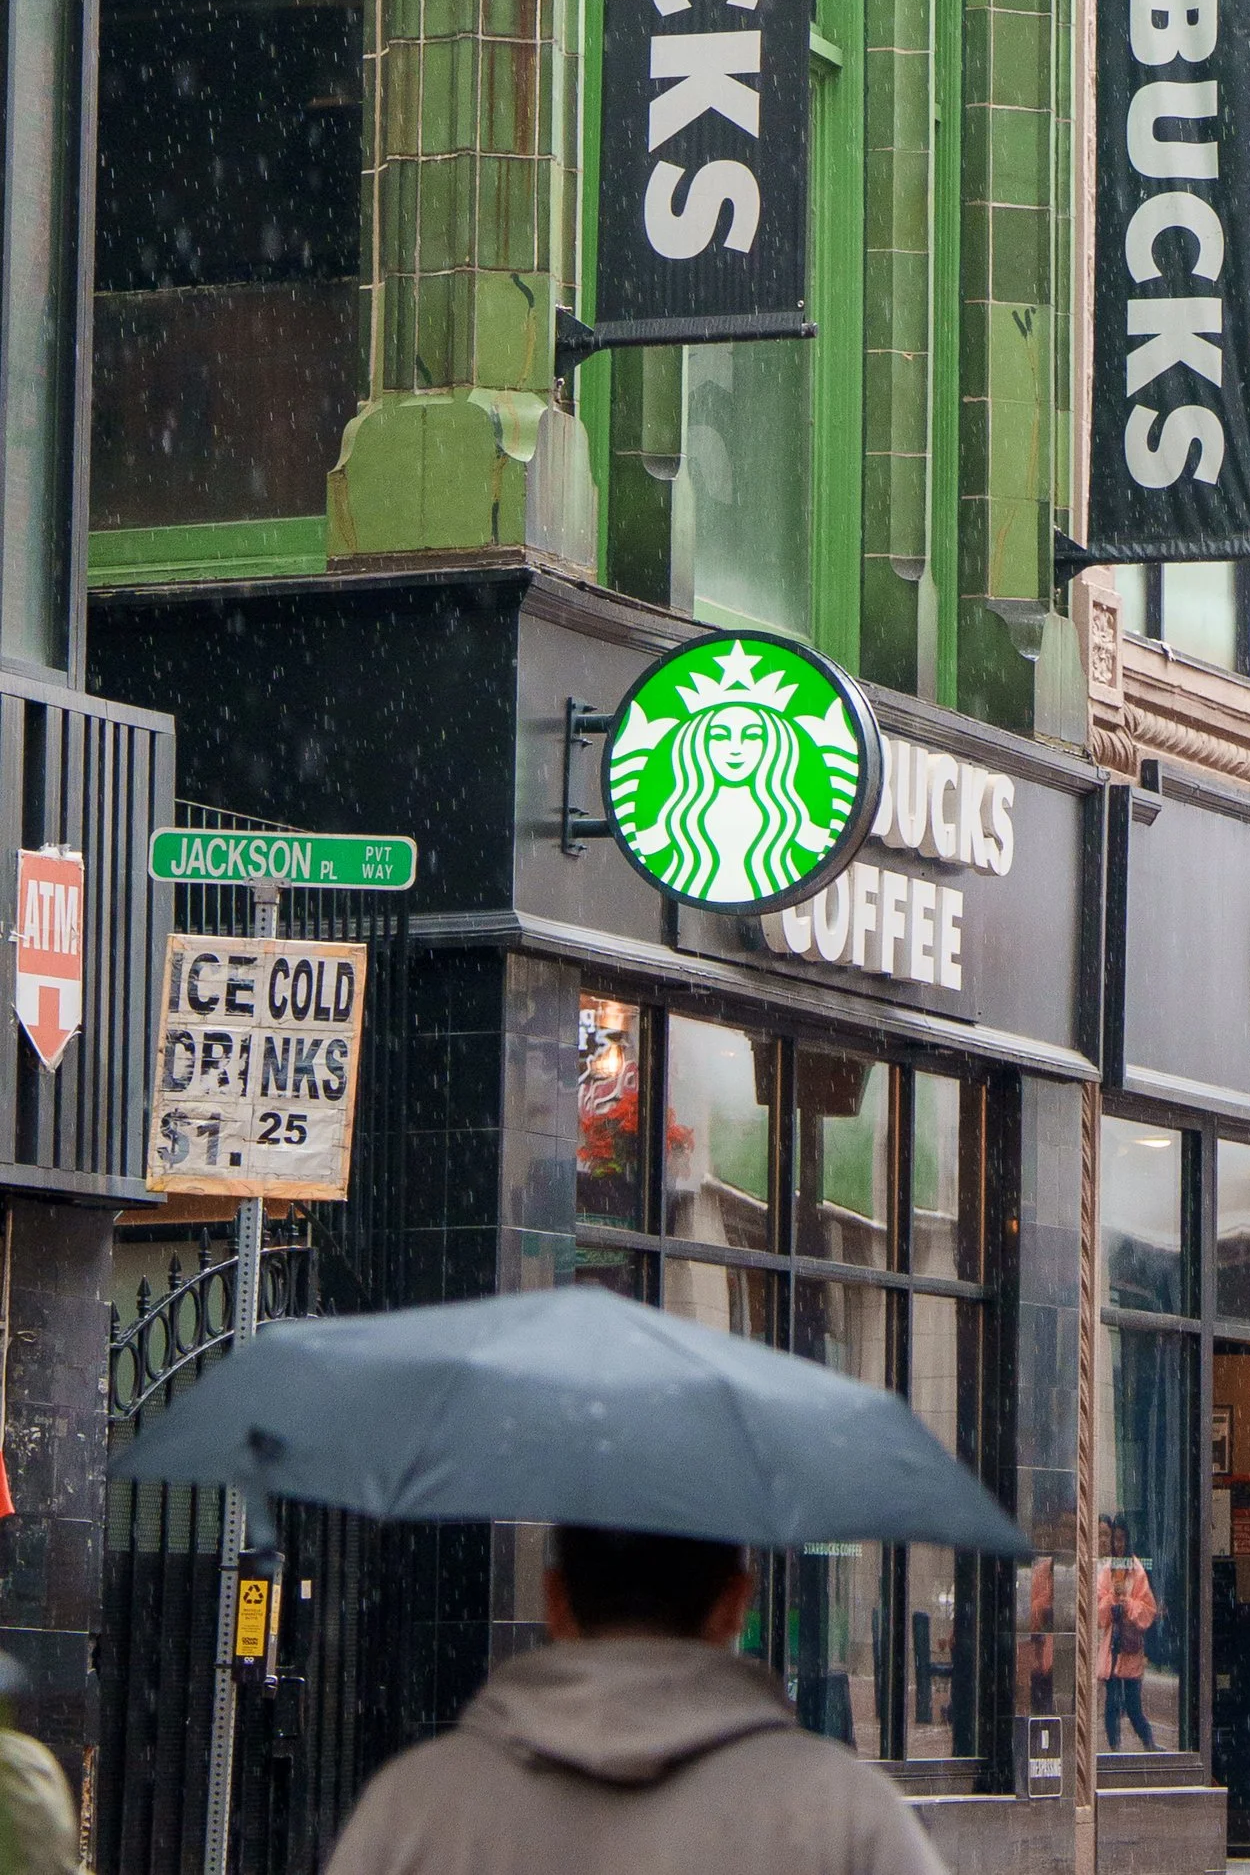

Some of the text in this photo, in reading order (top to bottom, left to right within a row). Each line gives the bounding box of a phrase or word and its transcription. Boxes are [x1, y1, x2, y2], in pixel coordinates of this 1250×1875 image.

[171, 837, 338, 880] JACKSON PL
[362, 863, 394, 880] WAY
[365, 846, 393, 862] PVT
[23, 879, 79, 956] ATM
[169, 952, 355, 1023] ICE COLD
[160, 1028, 349, 1102] DRINKS
